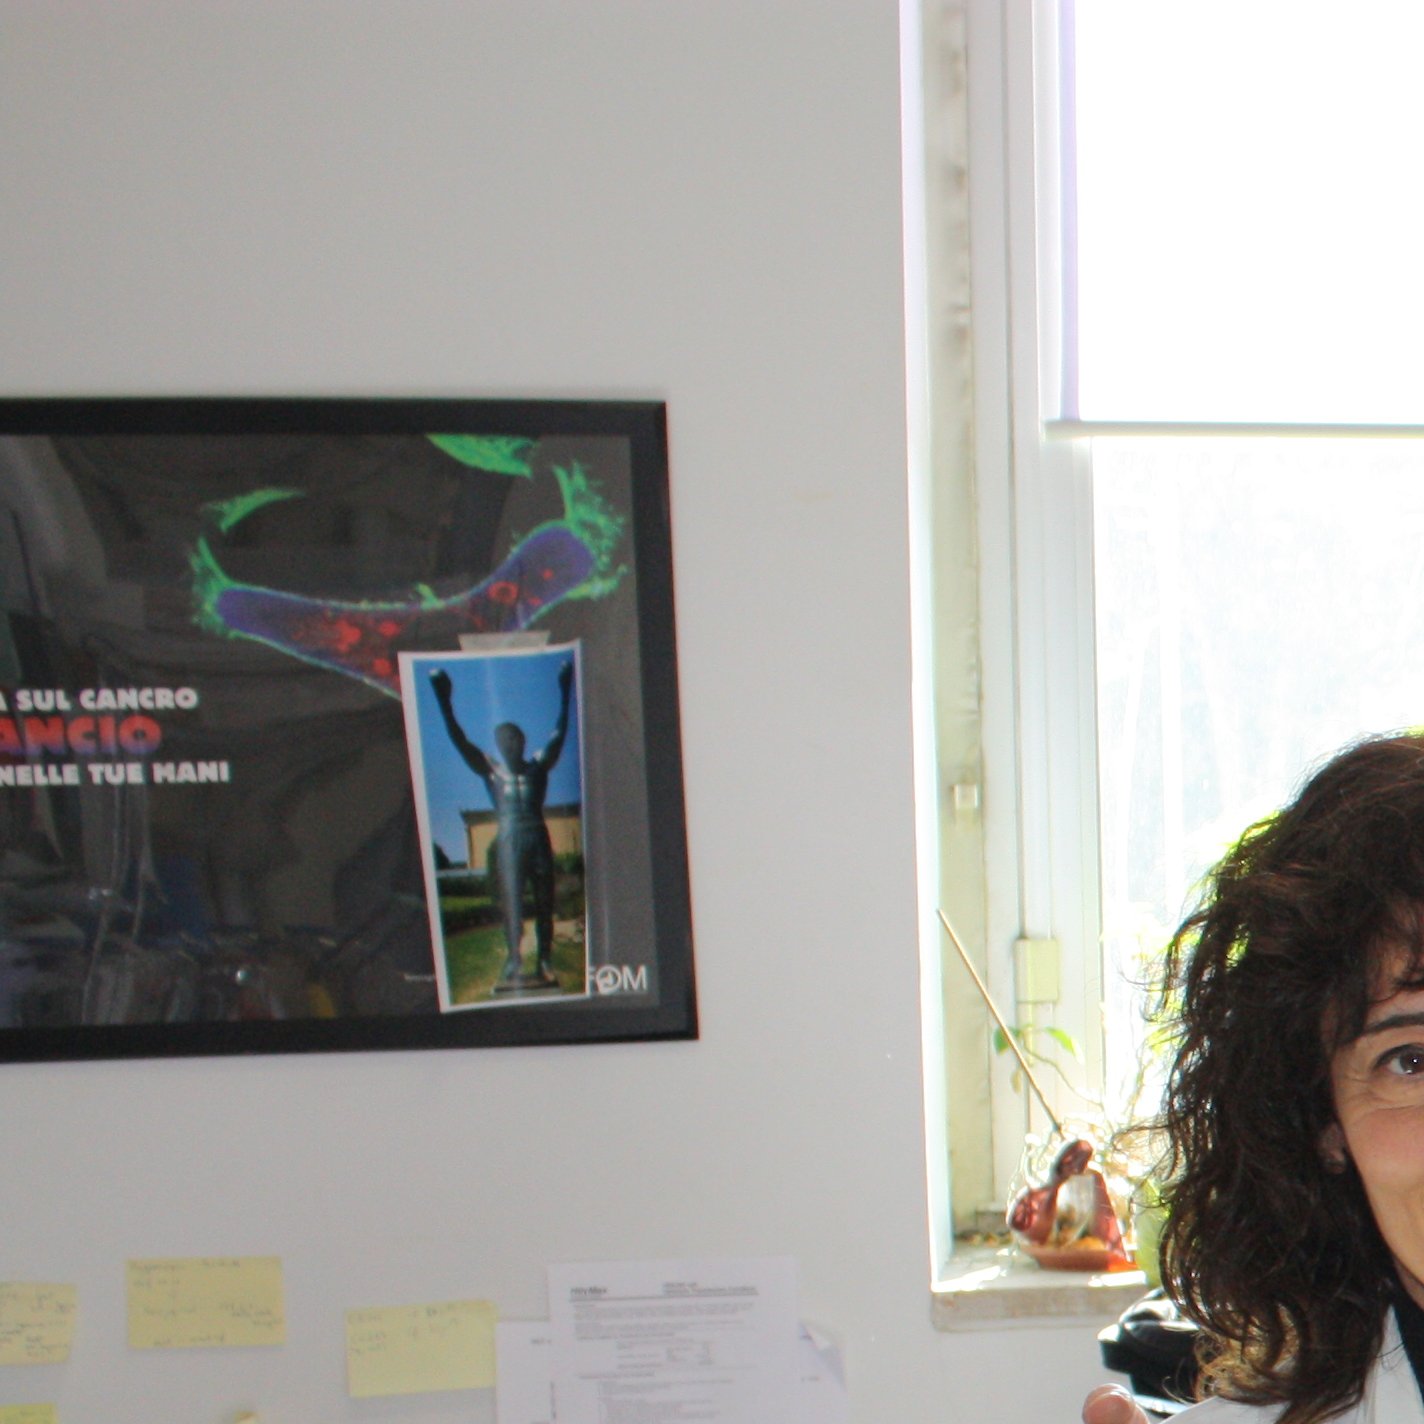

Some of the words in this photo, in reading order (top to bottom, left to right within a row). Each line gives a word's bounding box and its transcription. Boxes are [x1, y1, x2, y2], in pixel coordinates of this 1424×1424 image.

[16, 688, 71, 712] SUL
[79, 687, 198, 710] CANCRO
[0, 763, 79, 786] NELLE
[88, 762, 144, 785] TUE
[152, 761, 230, 783] MANI
